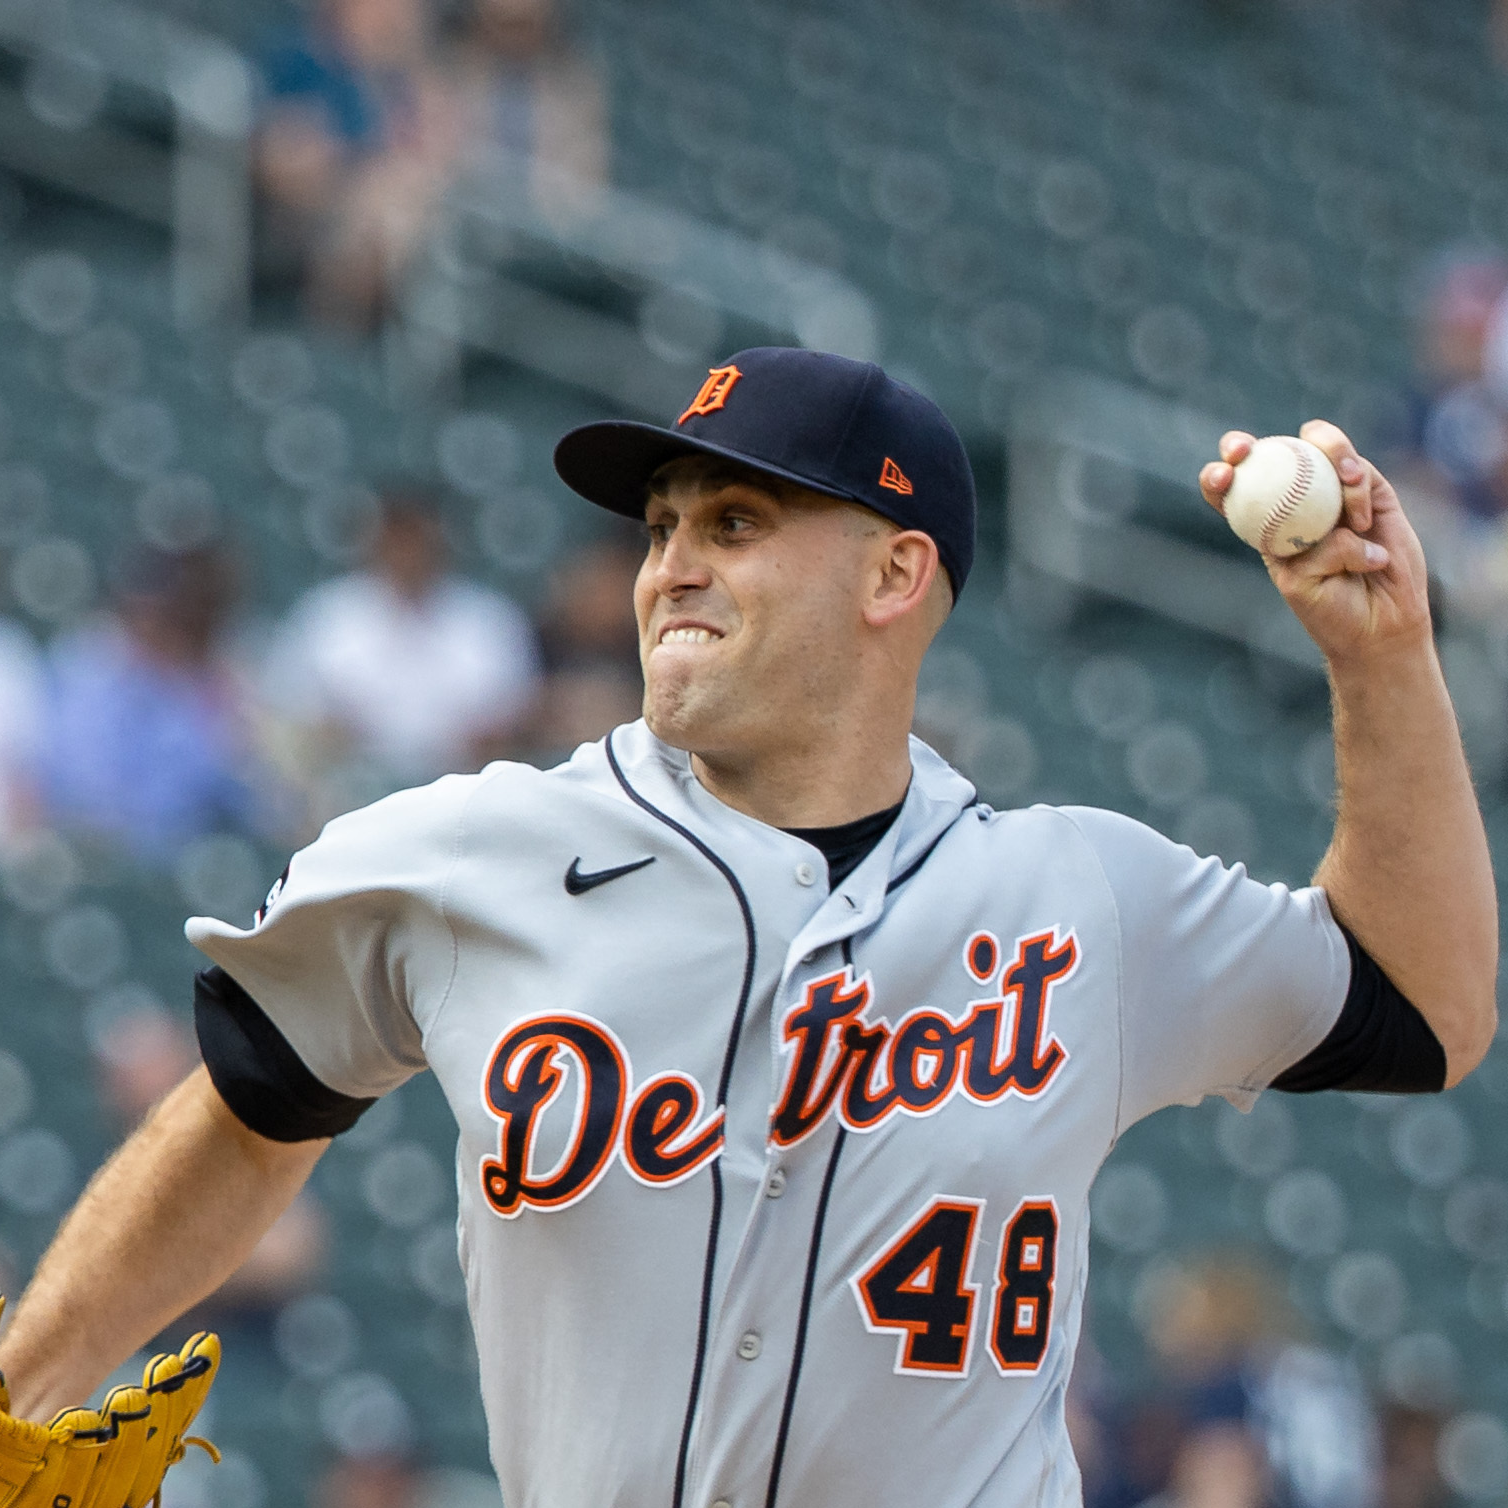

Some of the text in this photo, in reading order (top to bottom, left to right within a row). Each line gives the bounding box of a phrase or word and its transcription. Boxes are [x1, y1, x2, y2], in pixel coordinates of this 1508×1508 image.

[678, 364, 743, 425] D
[479, 925, 1080, 1219] Detroit
[849, 1194, 1061, 1378] 48
